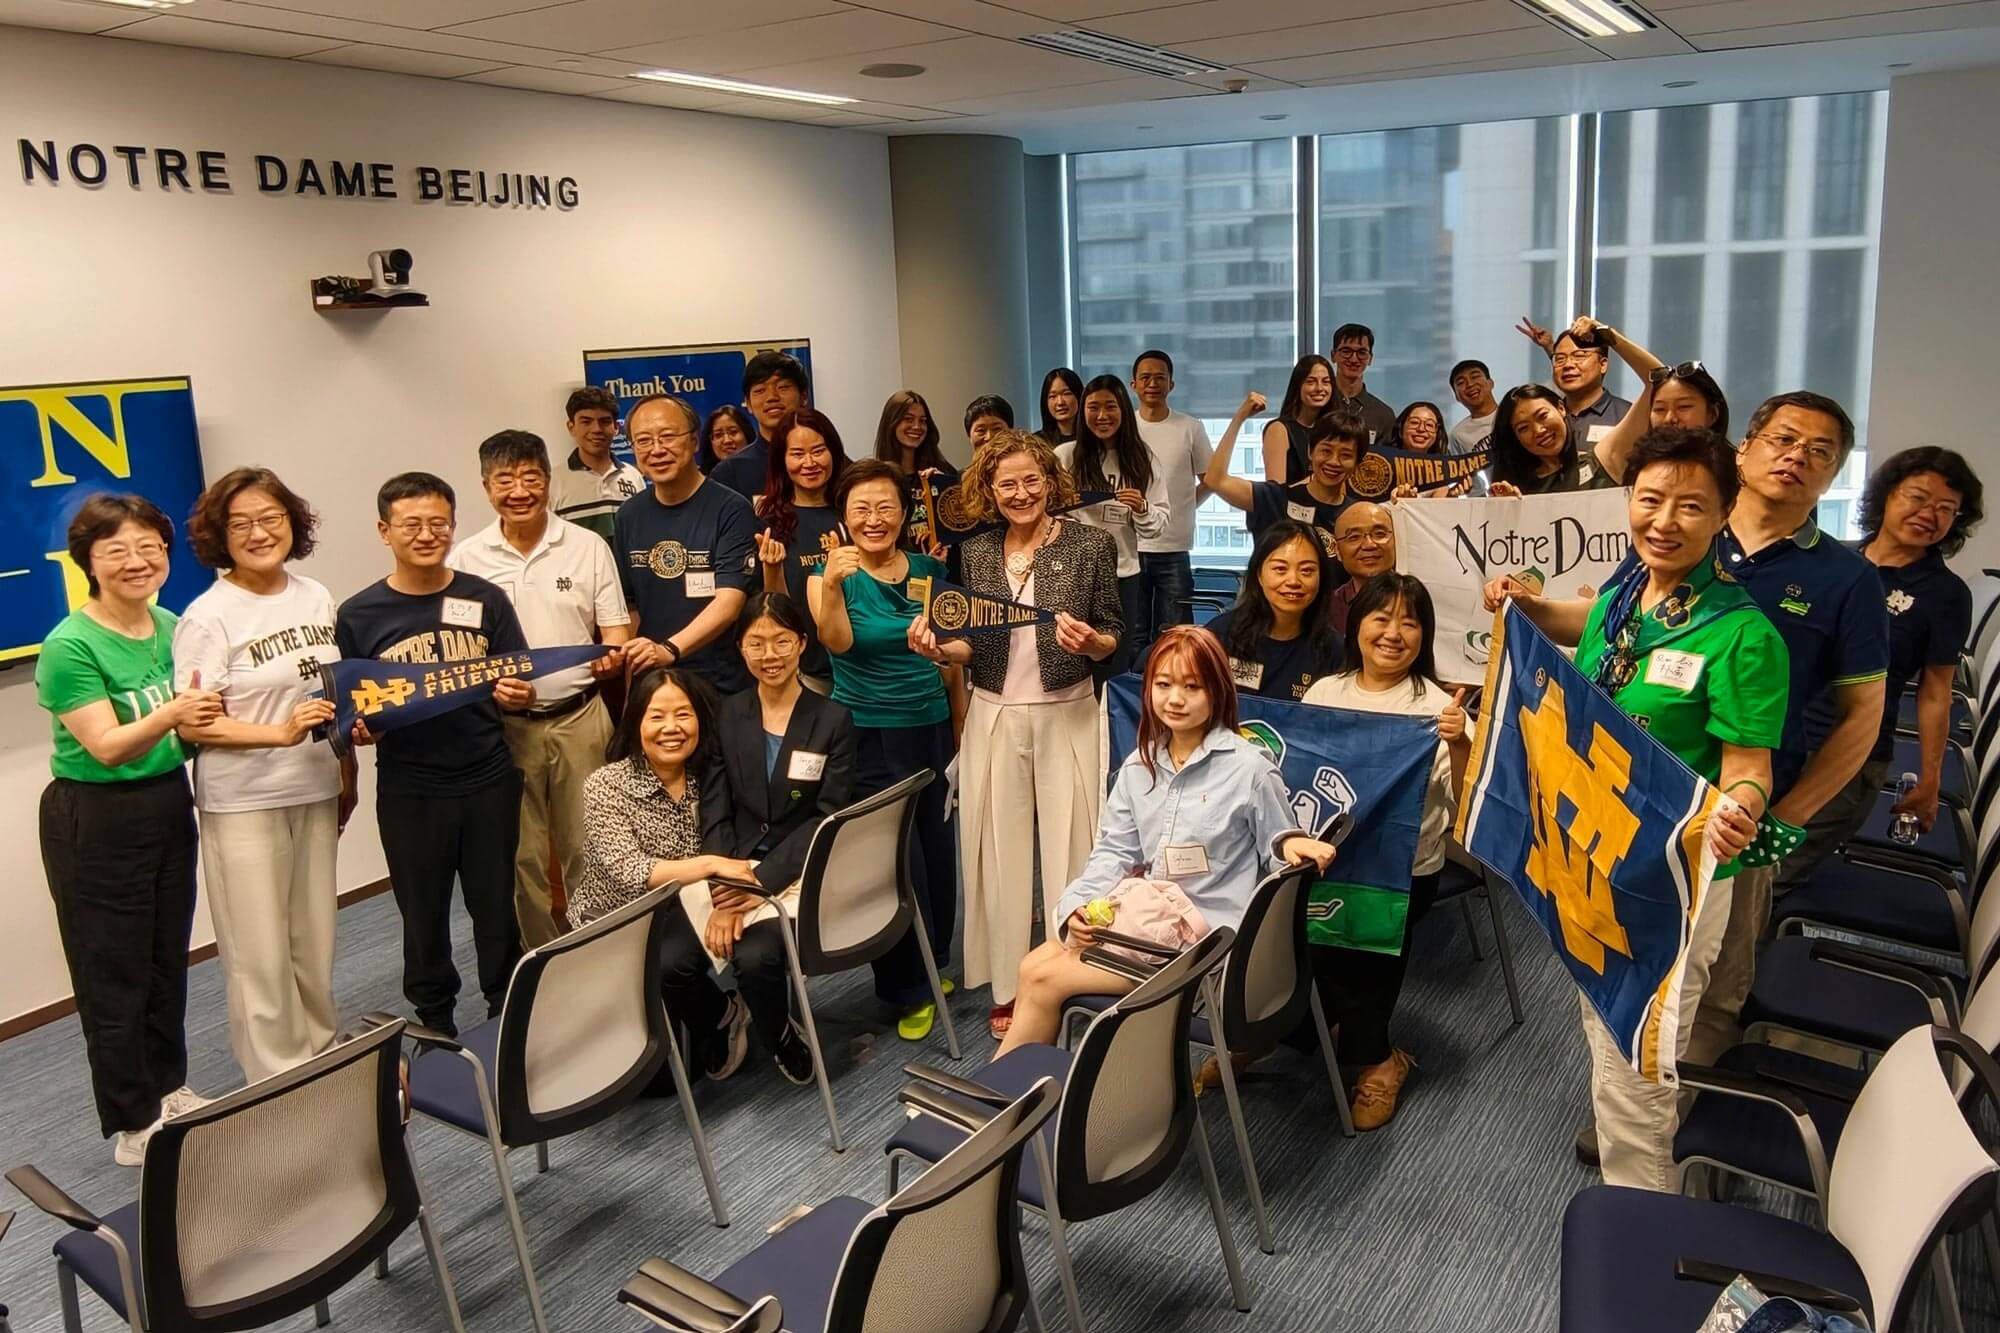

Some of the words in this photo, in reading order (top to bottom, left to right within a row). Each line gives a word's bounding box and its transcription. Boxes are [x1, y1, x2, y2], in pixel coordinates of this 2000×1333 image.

[18, 138, 232, 190] NOTRE
[254, 154, 398, 199] DAME
[416, 166, 579, 210] BEIJING
[604, 375, 668, 398] Thank
[669, 374, 706, 393] You
[1394, 456, 1444, 488] NOTRE
[1447, 453, 1488, 479] DAME
[800, 553, 827, 567] NOTR
[1452, 520, 1549, 578] Notre
[1550, 516, 1629, 579] Dam
[969, 596, 1004, 629] NOTRE
[1007, 606, 1040, 624] DAME
[249, 627, 303, 668] NOTRE
[379, 632, 439, 664] OTRE
[440, 630, 489, 662] DAME
[424, 656, 515, 683] ALUMNI
[424, 661, 534, 699] FRIENDS
